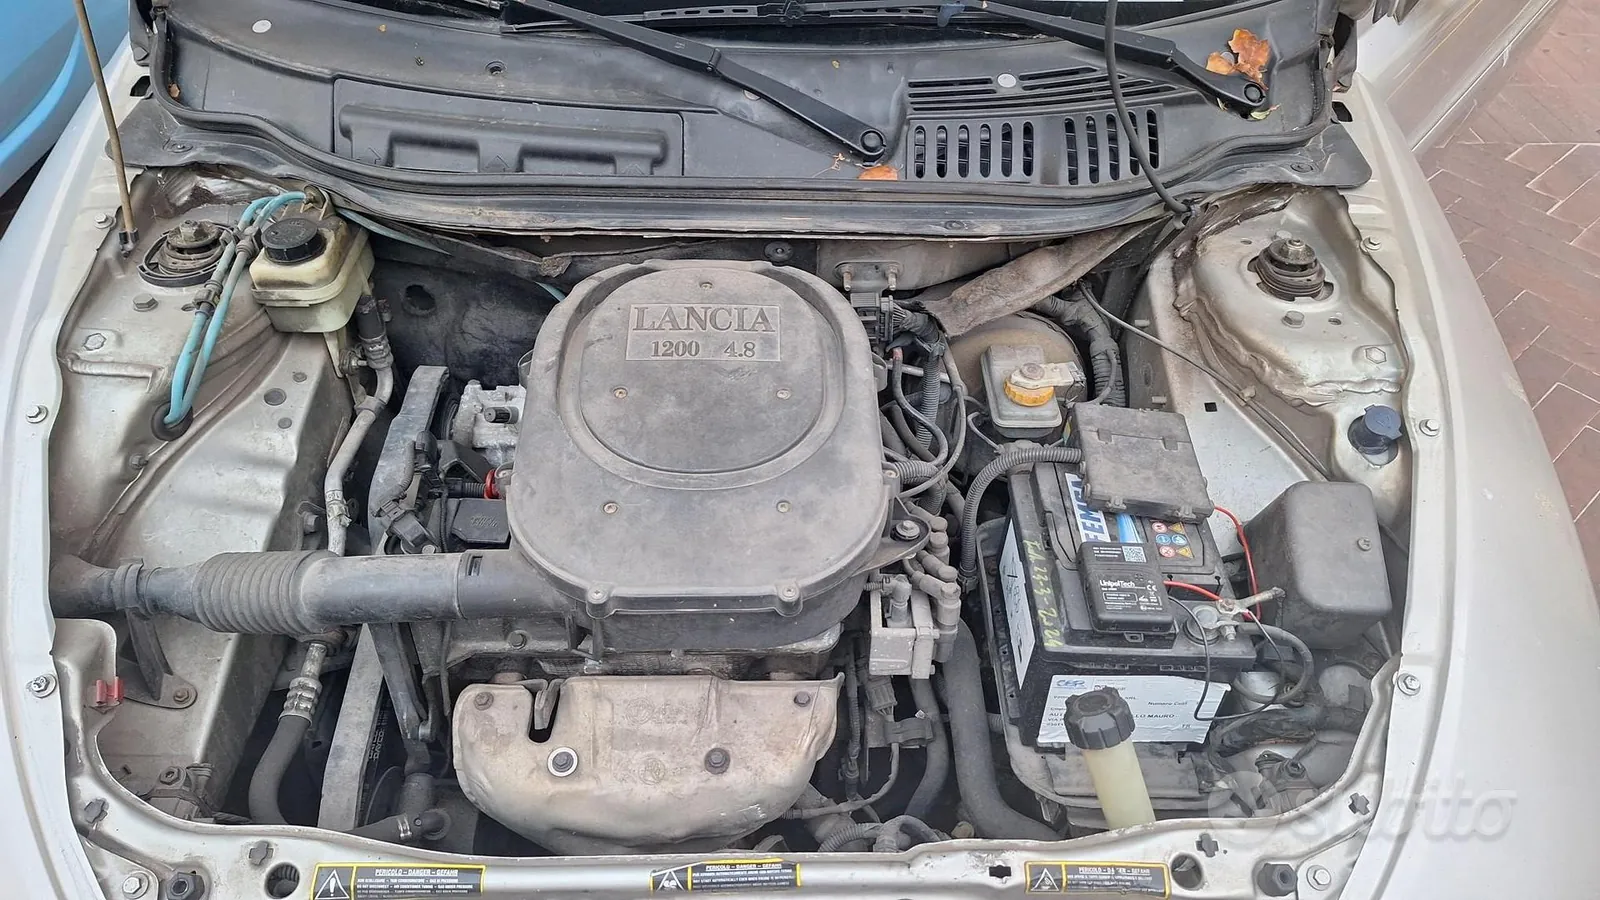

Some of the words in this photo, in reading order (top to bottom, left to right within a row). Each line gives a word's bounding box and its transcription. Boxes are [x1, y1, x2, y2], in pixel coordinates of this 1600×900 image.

[632, 306, 776, 333] LANCIA
[651, 340, 700, 358] 1200
[724, 341, 757, 358] 4.8
[1099, 579, 1136, 589] UnipolTech
